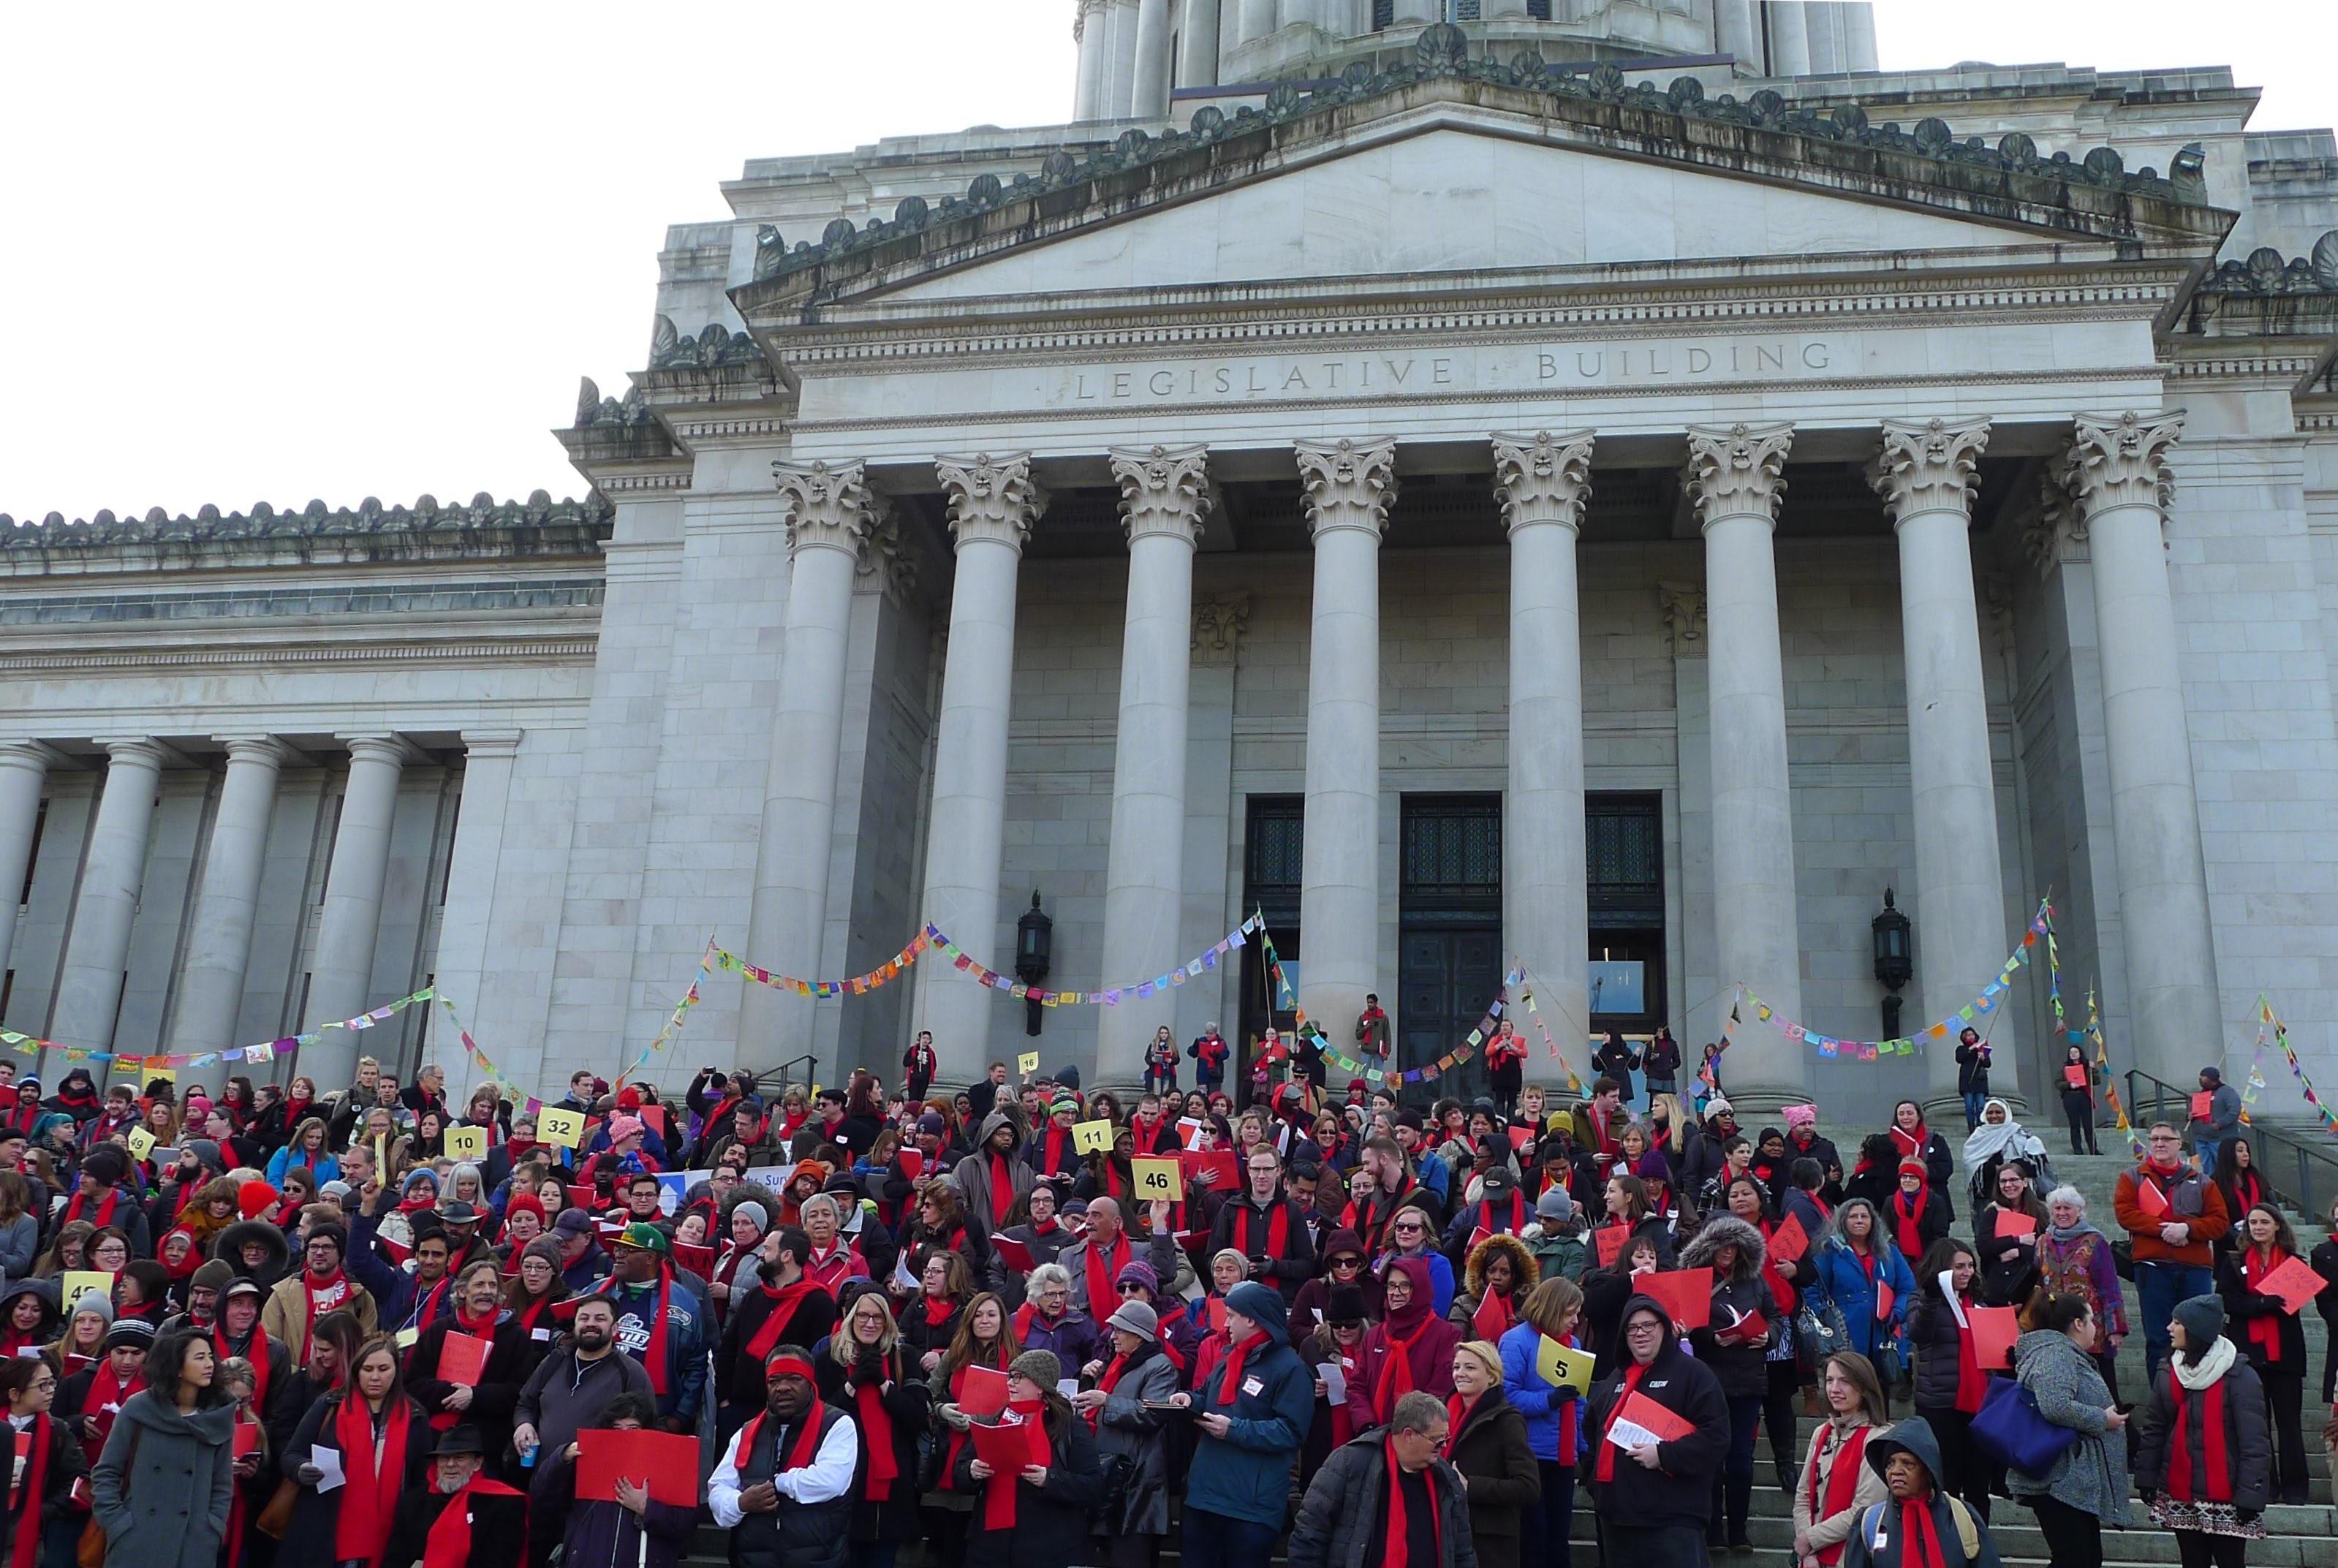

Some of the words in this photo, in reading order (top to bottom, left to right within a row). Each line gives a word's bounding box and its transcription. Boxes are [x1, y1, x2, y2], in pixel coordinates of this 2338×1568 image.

[1076, 357, 1452, 398] LEGISLATIVE
[1537, 343, 1831, 379] BUILDING
[1024, 1059, 1034, 1067] 16
[548, 1120, 570, 1135] 32
[131, 1137, 143, 1149] 49
[455, 1137, 473, 1148] 10
[1083, 1131, 1102, 1143] 11
[1146, 1173, 1168, 1188] 46
[1555, 1360, 1568, 1378] 5
